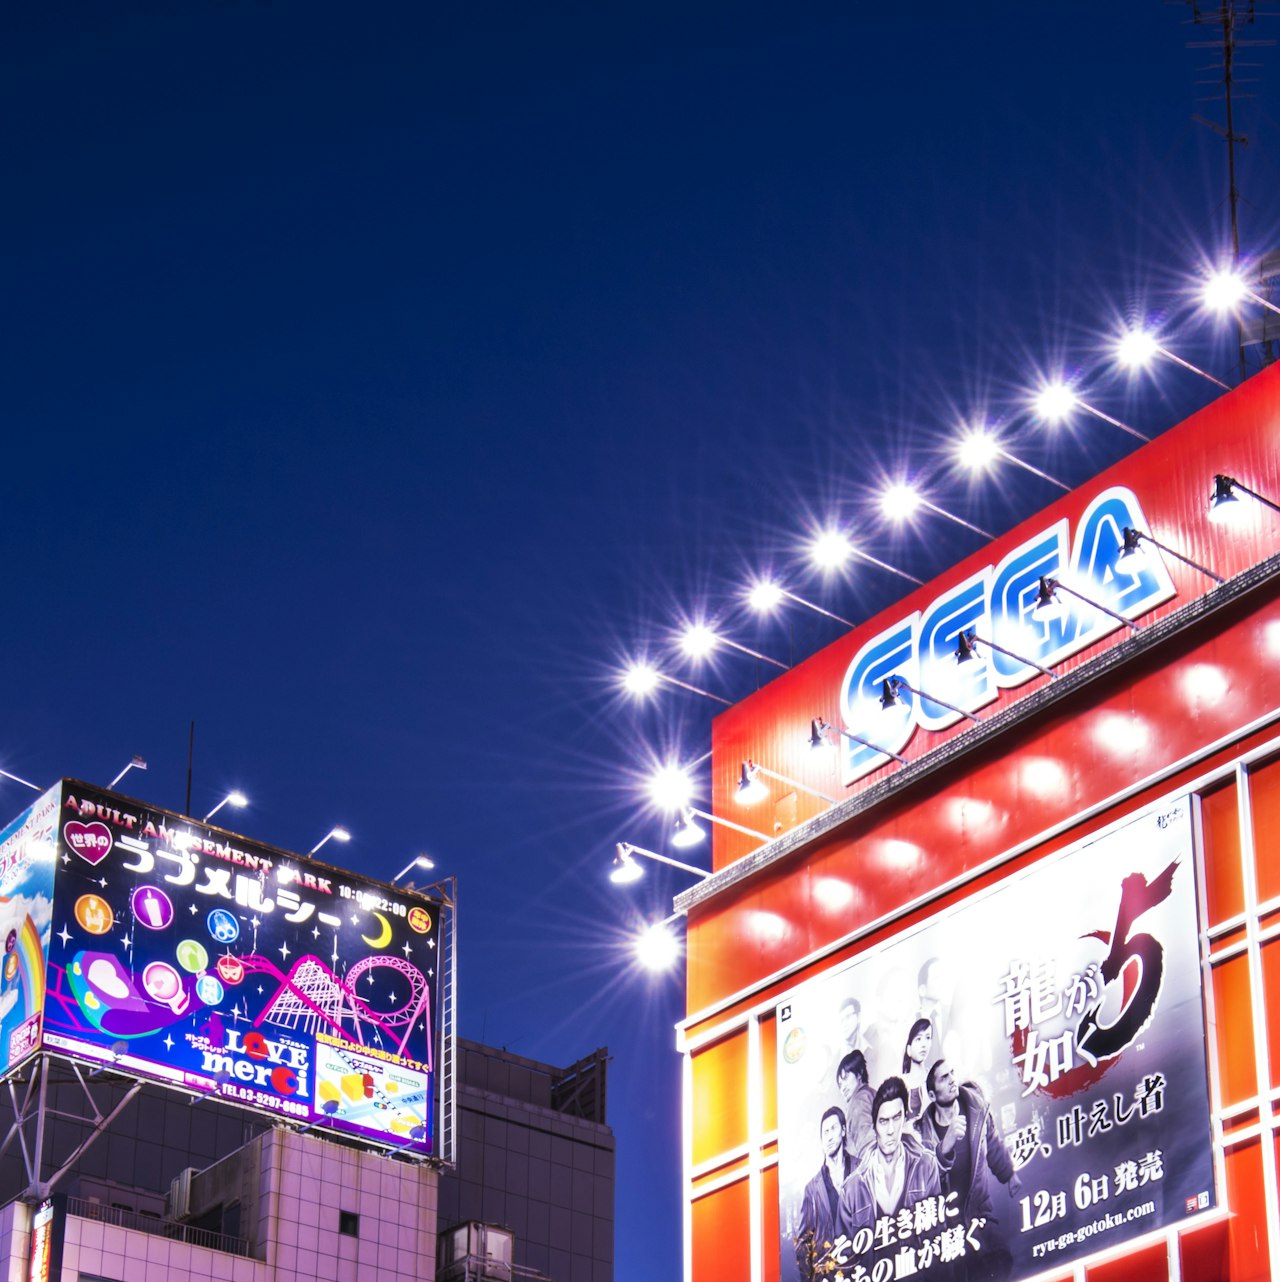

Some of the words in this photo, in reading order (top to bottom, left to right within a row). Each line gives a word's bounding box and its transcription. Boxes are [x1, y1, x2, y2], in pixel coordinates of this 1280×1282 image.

[840, 485, 1178, 787] SEGA
[64, 794, 137, 829] ADULT
[70, 832, 110, 851] 世界の
[114, 834, 342, 928] ラブメルシー
[202, 1049, 310, 1098] merci
[225, 1028, 310, 1070] LOVE
[1010, 1072, 1168, 1172] 夢、叶えし者
[830, 1189, 962, 1267] その生き様に
[1031, 1197, 1157, 1259] ryu-ga-gotoku.com
